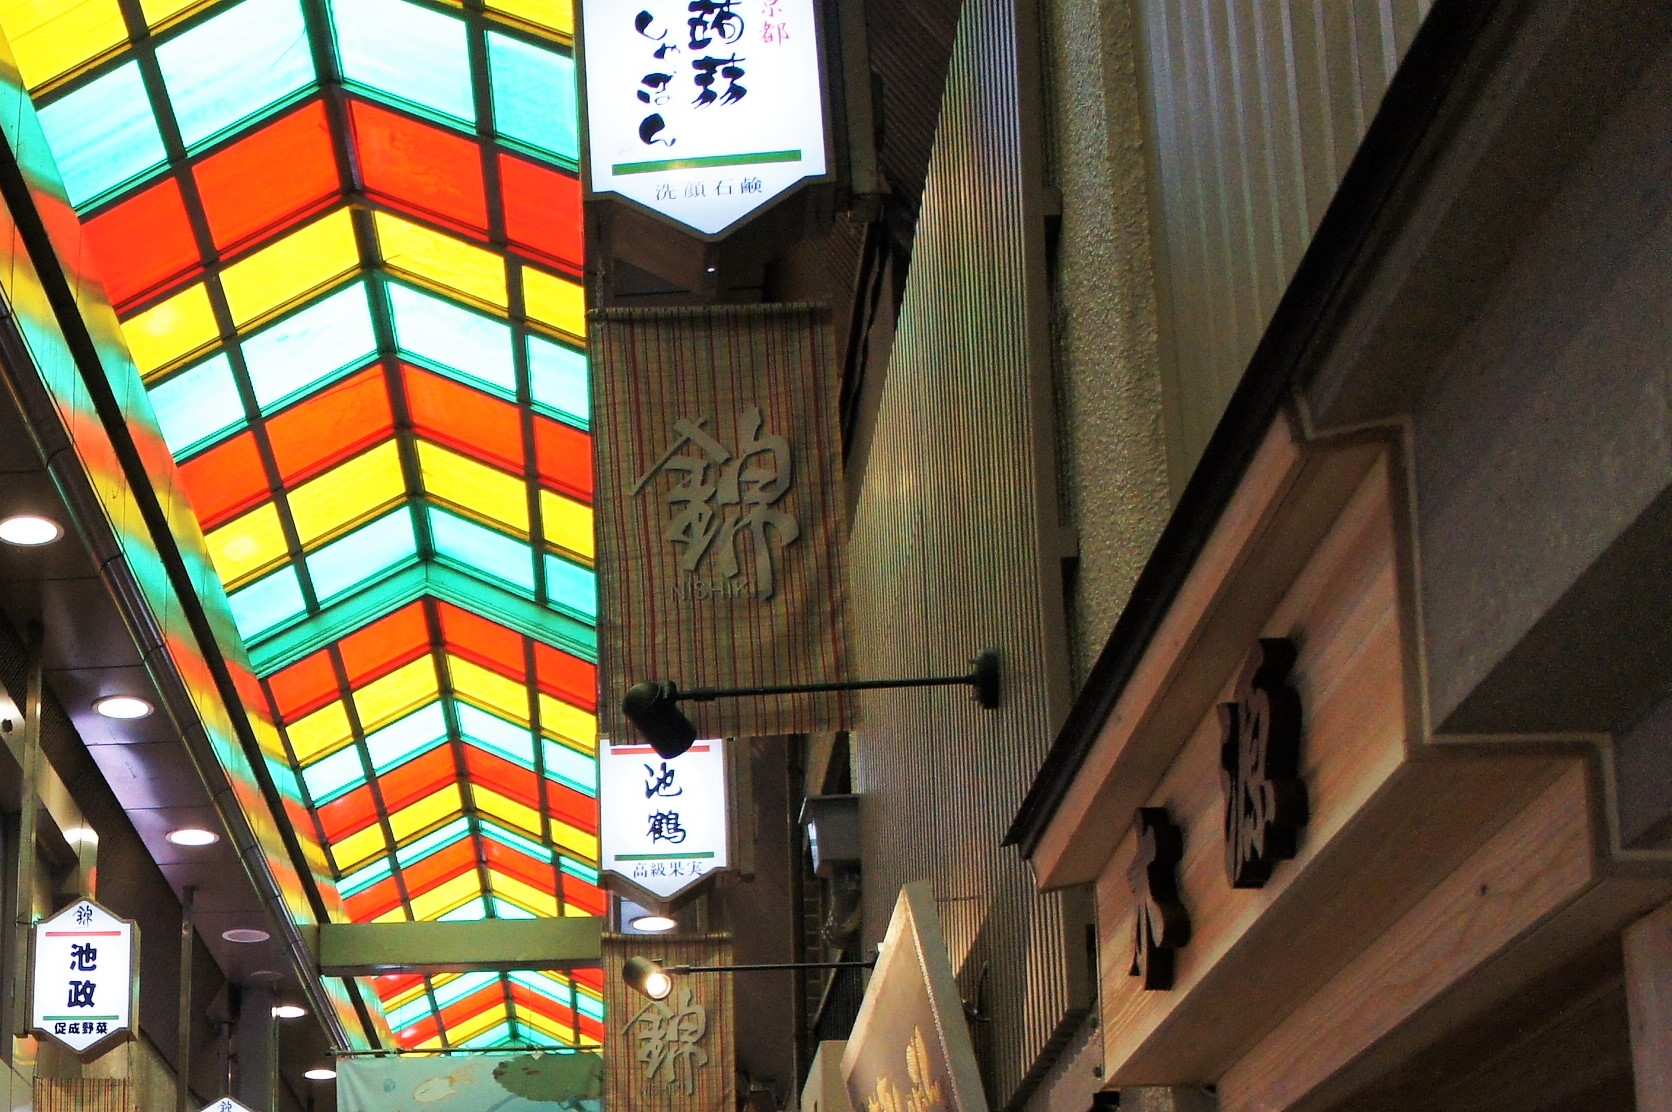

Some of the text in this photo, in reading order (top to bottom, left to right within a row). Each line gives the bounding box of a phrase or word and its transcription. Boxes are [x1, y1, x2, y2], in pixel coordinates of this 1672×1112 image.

[630, 404, 799, 602] 錦
[643, 761, 687, 845] 池鶴
[632, 861, 705, 879] 高級果実
[72, 904, 94, 929] 錦
[67, 942, 98, 1009] 池政
[54, 1021, 109, 1036] 促成野菜
